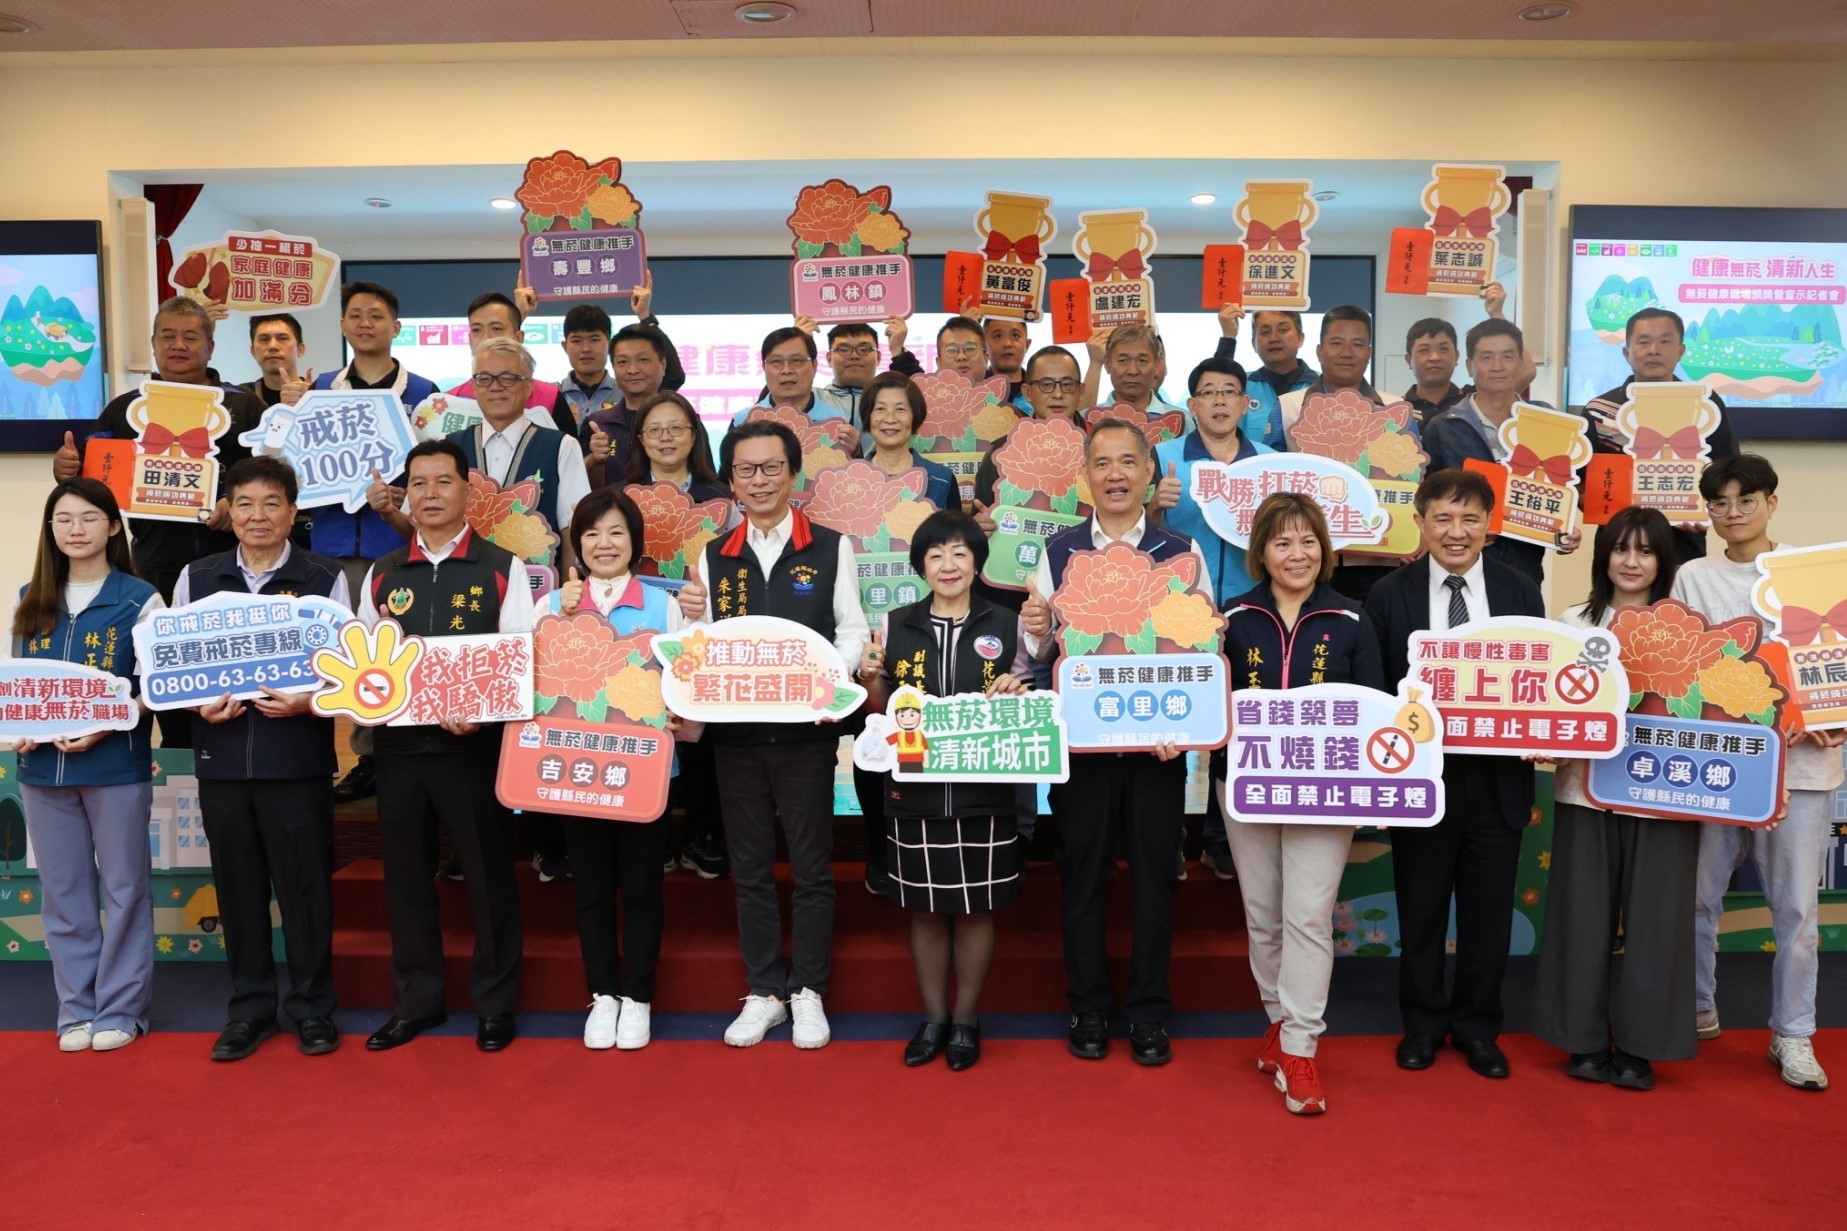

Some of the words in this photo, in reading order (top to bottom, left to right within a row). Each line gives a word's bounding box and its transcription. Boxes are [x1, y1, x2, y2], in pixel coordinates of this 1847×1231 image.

[236, 239, 305, 255] 少抽一根菸
[551, 236, 634, 252] 無菸健康推手
[232, 256, 312, 278] 家庭健康
[553, 258, 615, 276] 壽豐鄉
[821, 262, 901, 278] 無菸健康推手
[1434, 251, 1483, 267] 葉志誠
[1692, 258, 1762, 278] 健康無菸
[1766, 259, 1835, 278] 清新人生
[986, 275, 1031, 292] 黃富俊
[1249, 265, 1295, 279] 徐進文
[233, 279, 311, 304] 加滿分
[554, 284, 618, 295] 守護縣民的健康
[822, 284, 884, 301] 鳳林鎮
[822, 305, 885, 316] 守護縣民的健康
[1095, 295, 1140, 310] 盧建宏
[298, 403, 376, 449] 戒菸
[302, 440, 393, 486] 100分
[144, 470, 201, 489] 田清文
[1638, 476, 1693, 491] 王志宏
[1509, 490, 1560, 514] 王裕平
[529, 575, 544, 589] 手
[469, 585, 484, 613] 鄉長
[717, 577, 732, 618] 朱家
[156, 603, 290, 636] 你戒菸我挺你
[153, 628, 303, 668] 免費戒菸專線
[706, 639, 806, 666] 推動無菸
[1420, 641, 1550, 661] 不讓慢性毒害
[421, 637, 529, 685] 我拒菸
[151, 660, 314, 696] 0800-63-63-63
[1098, 665, 1213, 684] 無菸健康推手
[1420, 667, 1548, 703] 纏上你
[693, 673, 813, 702] 繁花盛開
[410, 678, 523, 724] 我驕傲
[1098, 695, 1187, 718] 富里鄉
[1237, 700, 1359, 726] 省錢築夢
[923, 696, 1054, 732] 無菸環境
[546, 729, 657, 756] 無菸健康推手
[932, 730, 1051, 771] 清新城市
[1237, 735, 1360, 771] 不燒錢
[1634, 727, 1766, 756] 無菸健康推手
[541, 760, 627, 787] 吉安鄉
[1631, 757, 1731, 788] 卓溪鄉
[537, 787, 624, 808] 守護縣民的健康
[1245, 784, 1427, 809] 全面禁止電子煙
[1628, 787, 1731, 811] 守護縣民的健康
